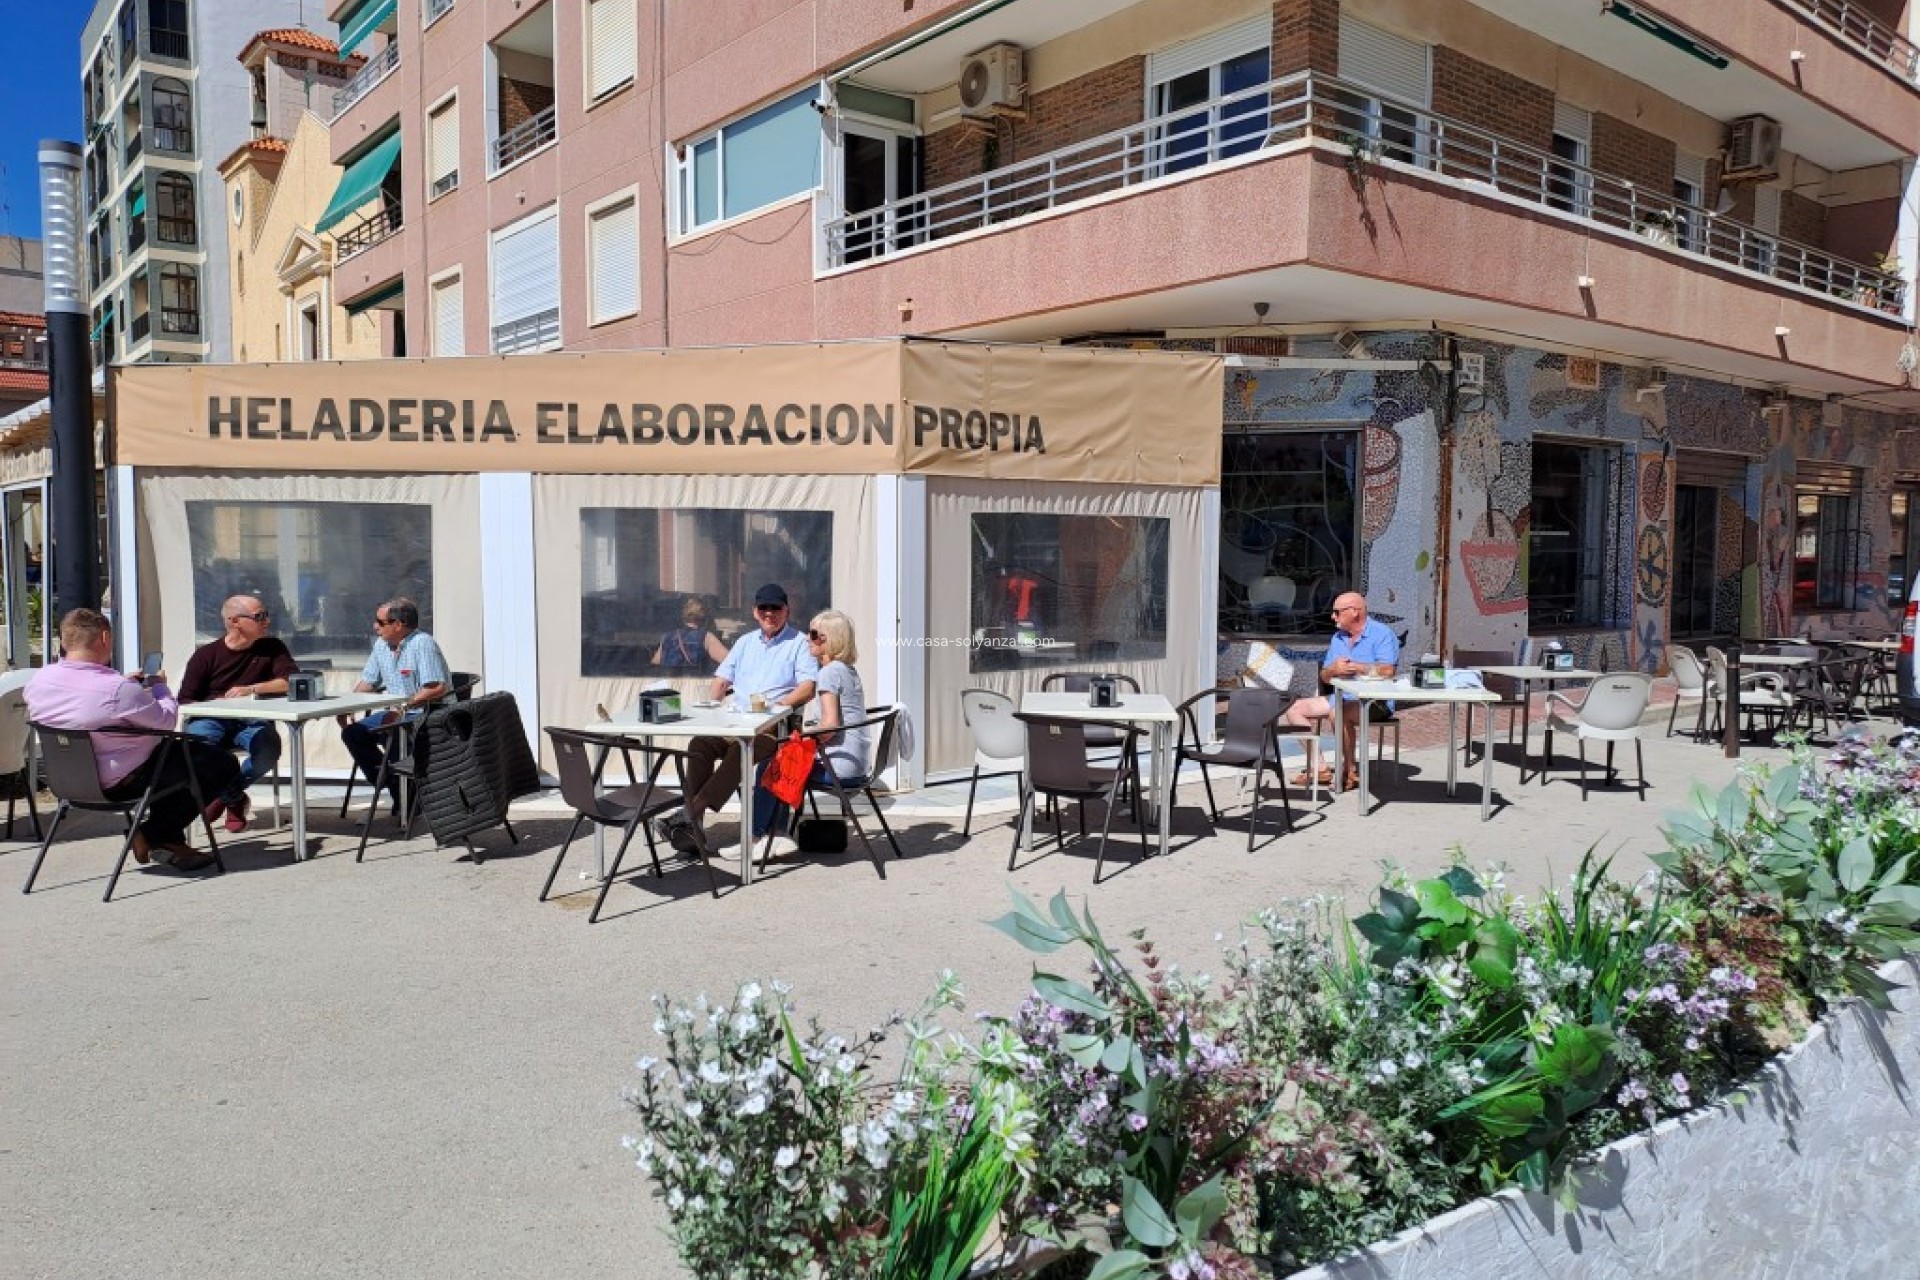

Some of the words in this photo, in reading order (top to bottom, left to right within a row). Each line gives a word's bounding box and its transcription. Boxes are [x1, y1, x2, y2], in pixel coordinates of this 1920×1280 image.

[208, 396, 516, 442] HELADERIA
[536, 403, 893, 446] ELABORACION
[913, 404, 1046, 454] PROPIA
